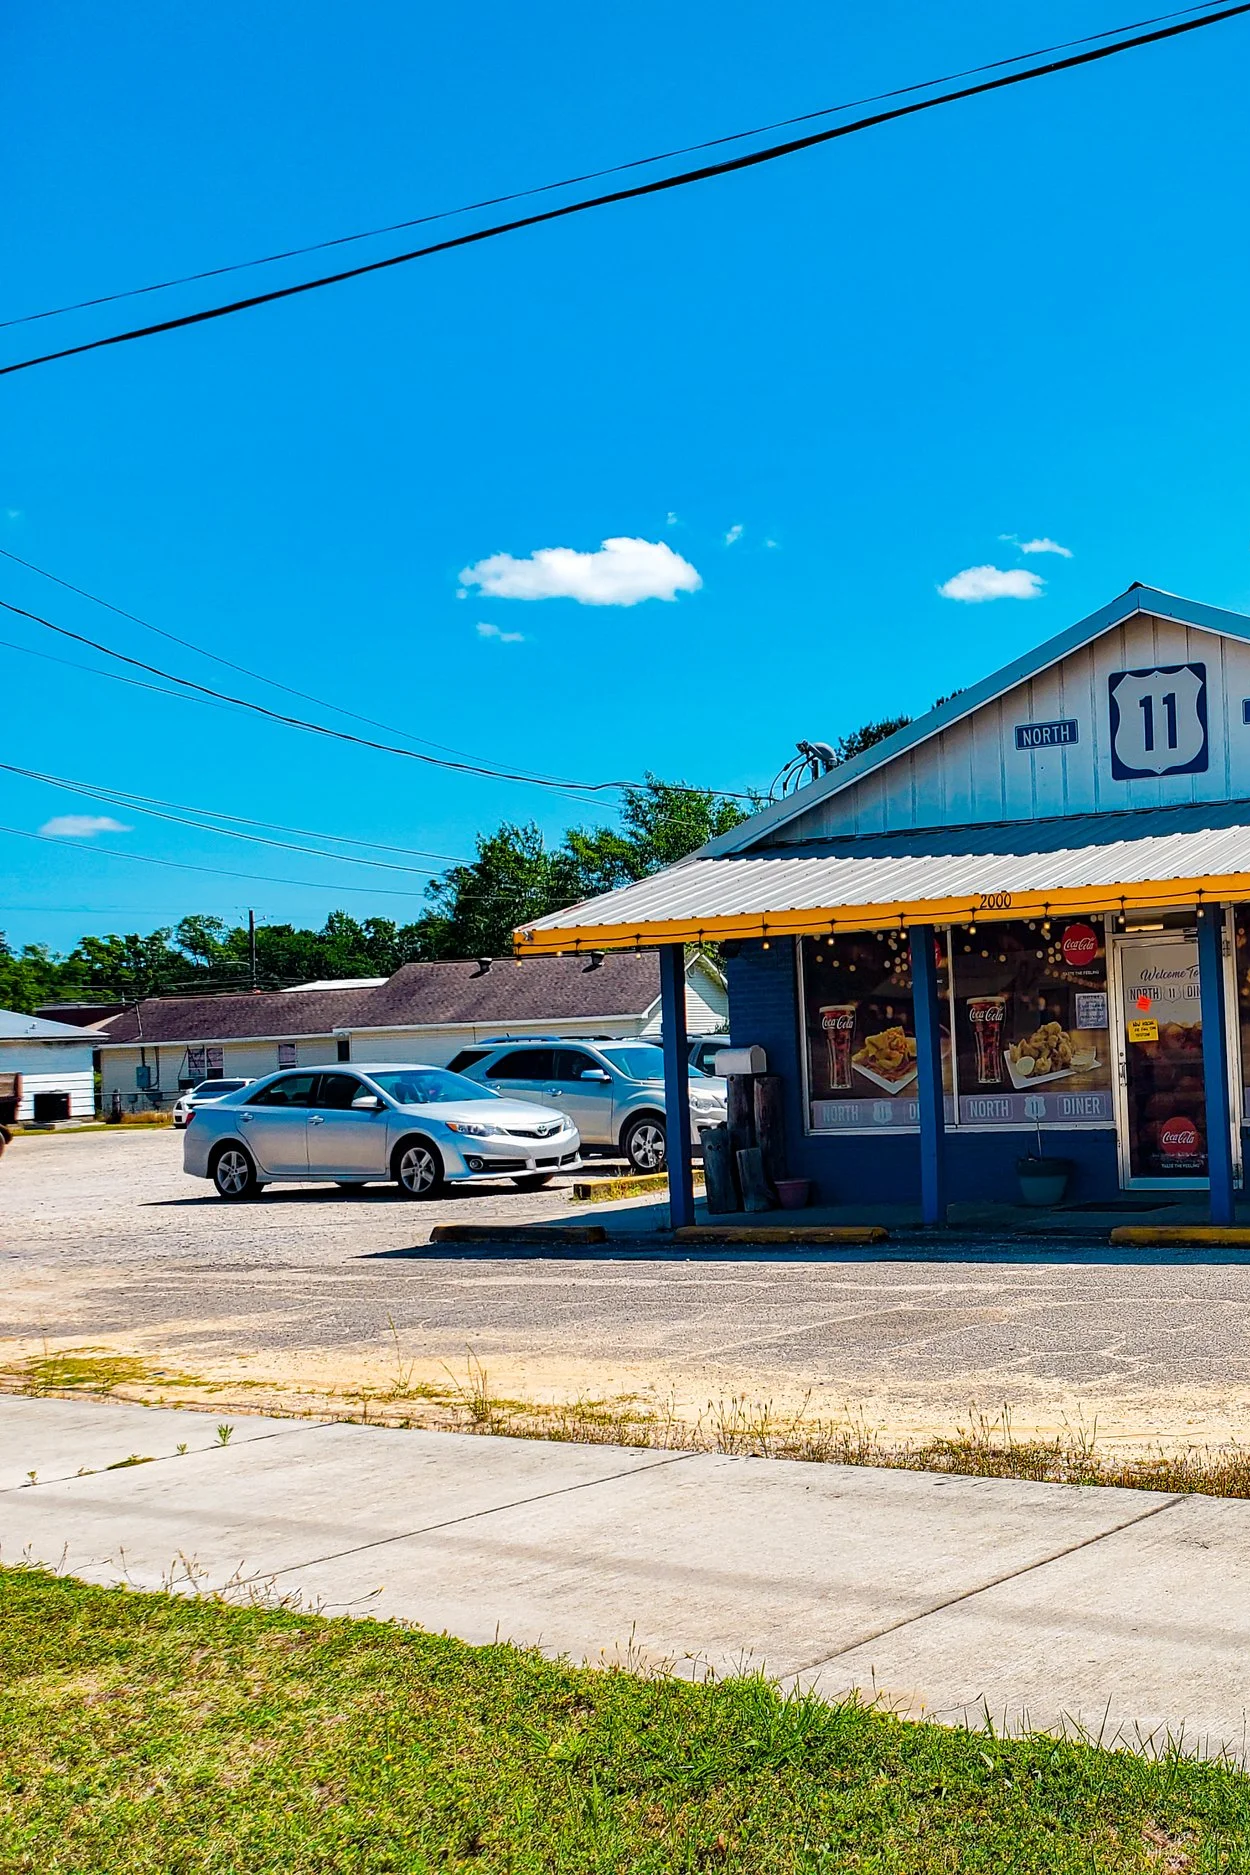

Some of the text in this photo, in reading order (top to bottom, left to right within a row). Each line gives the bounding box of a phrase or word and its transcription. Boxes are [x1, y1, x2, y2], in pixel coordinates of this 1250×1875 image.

[1023, 725, 1070, 746] NORTH
[1139, 692, 1177, 751] 11
[981, 893, 1011, 908] 2000
[1063, 936, 1097, 951] Coca-Cola
[1140, 966, 1186, 981] Welcome
[1130, 987, 1159, 1000] NORTH
[969, 1006, 1005, 1022] Coca-Cola
[822, 1015, 854, 1030] Coca-Cola
[823, 1105, 859, 1122] NORTH
[969, 1097, 1100, 1118] NORTH 11 DINER
[1162, 1131, 1196, 1144] Coca-Cola
